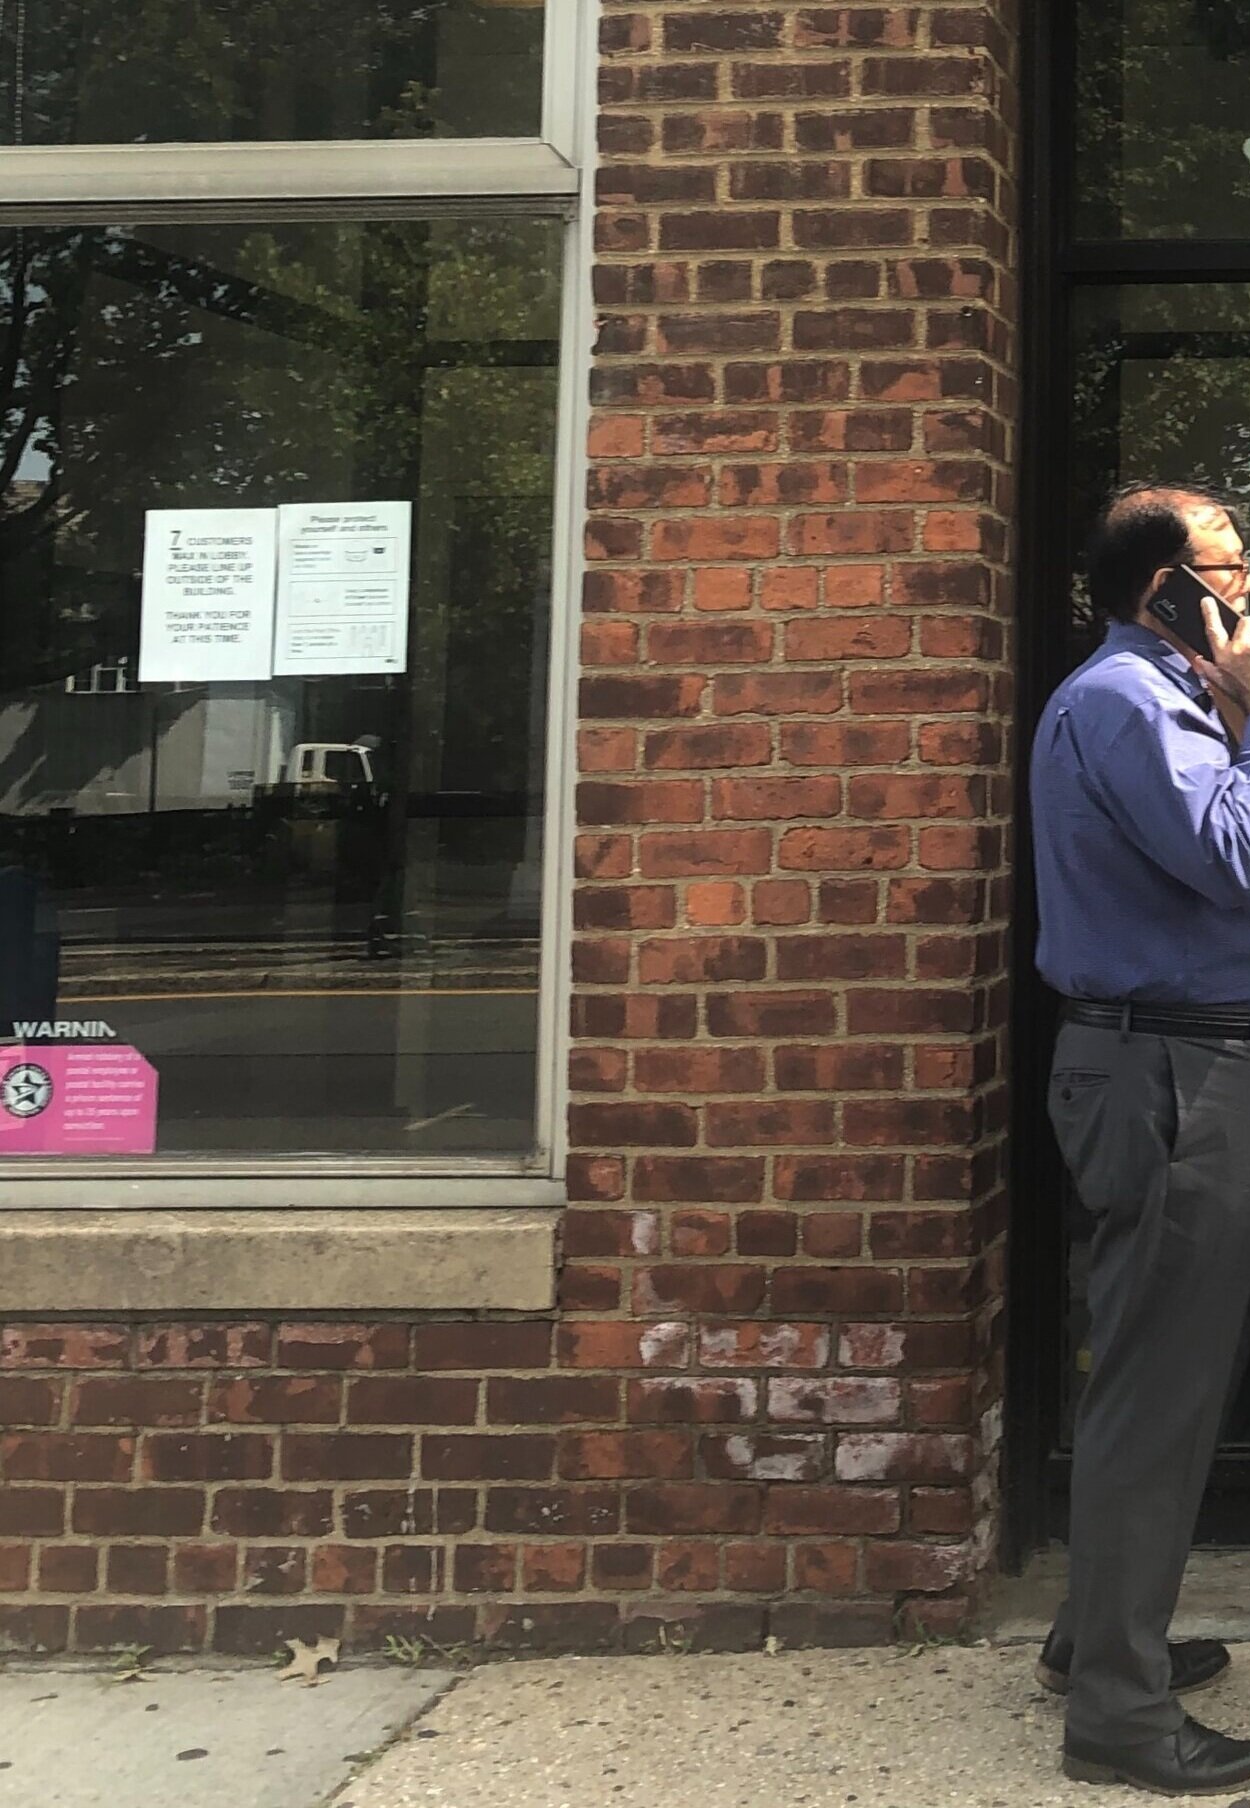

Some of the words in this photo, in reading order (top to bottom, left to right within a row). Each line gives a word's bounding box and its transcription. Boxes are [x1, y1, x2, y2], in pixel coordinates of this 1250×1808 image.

[169, 530, 182, 550] 7
[186, 536, 254, 546] CUSTOMERS
[166, 563, 209, 572] PLEASE
[211, 563, 236, 572] LINE
[238, 562, 254, 572] UP
[166, 575, 213, 584] OUTSIDE
[216, 575, 230, 584] OF
[232, 574, 254, 584] THE
[165, 611, 200, 620] THANK
[204, 610, 226, 620] YOU
[228, 610, 252, 619] FOR
[165, 622, 195, 632] YOUR
[197, 622, 251, 632] PATIENCE
